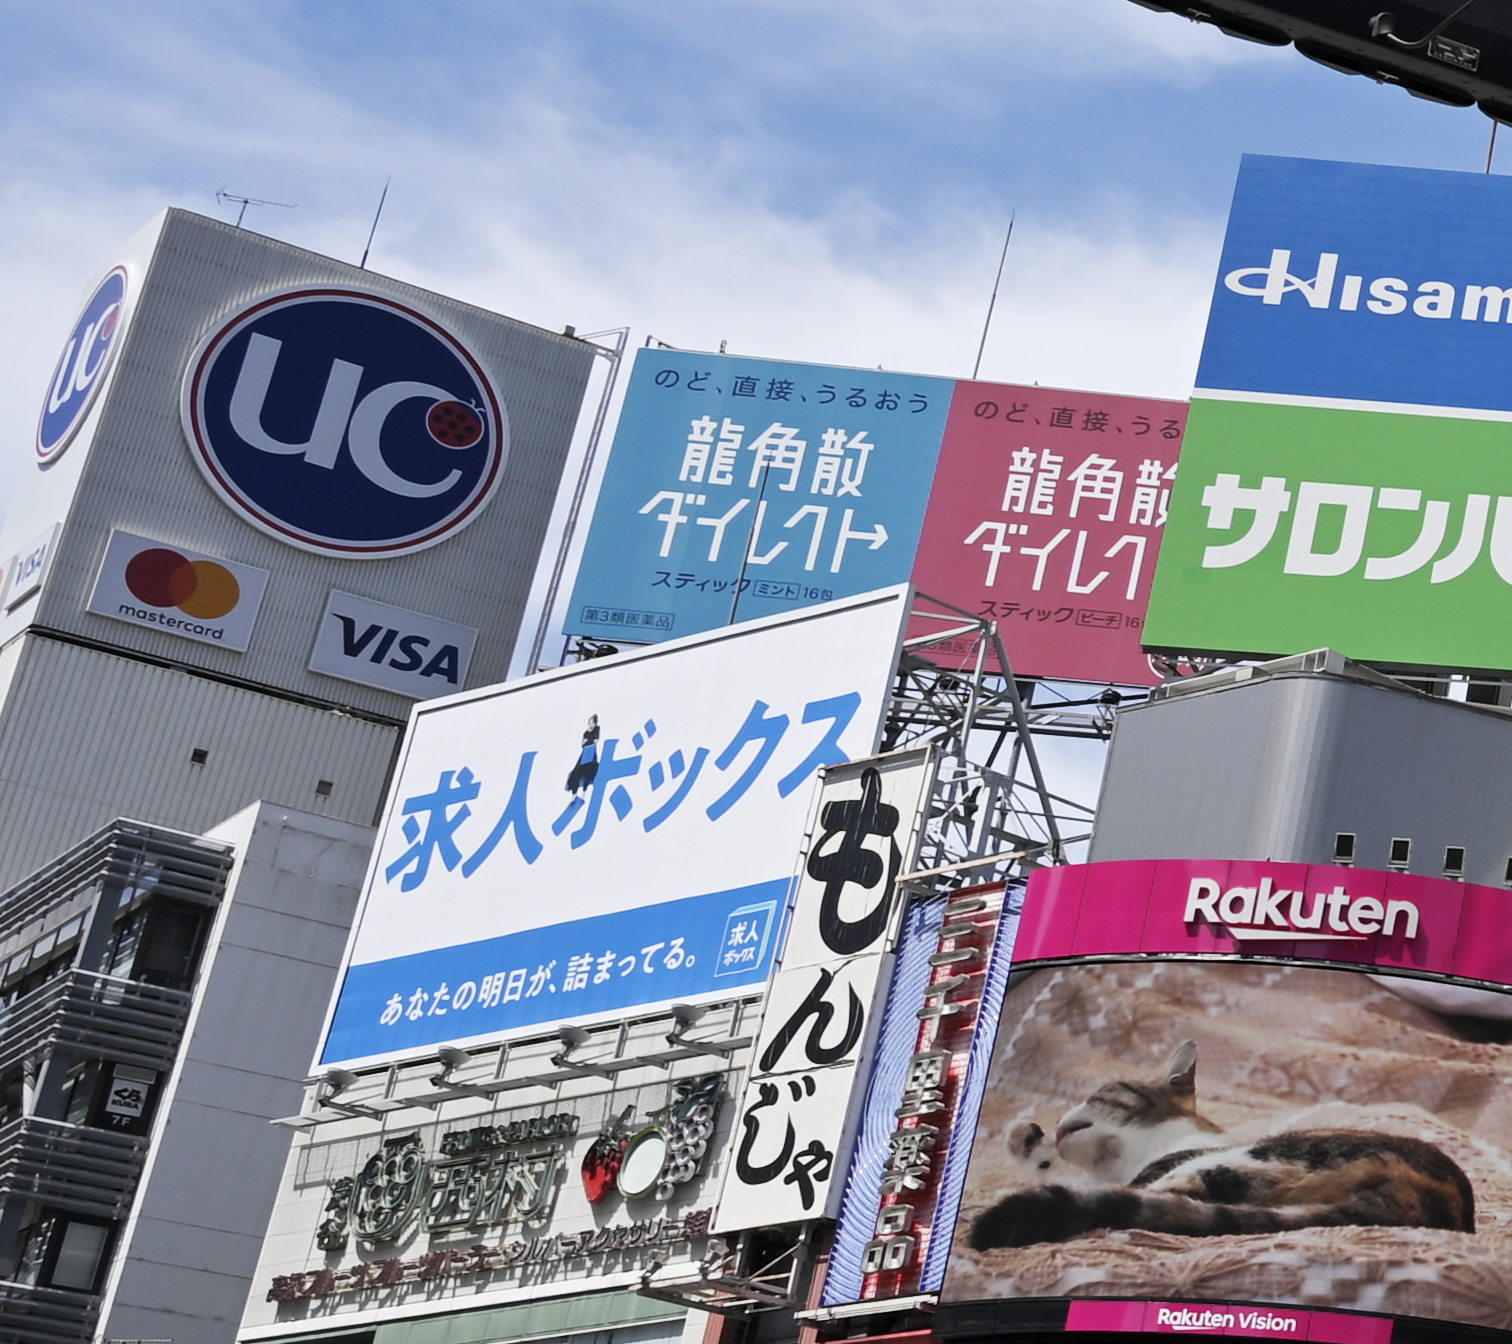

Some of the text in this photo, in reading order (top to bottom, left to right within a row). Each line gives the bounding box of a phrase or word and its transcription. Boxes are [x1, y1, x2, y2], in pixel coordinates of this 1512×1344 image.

[654, 368, 929, 414] のど、直接、うるおう
[678, 414, 875, 499] 龍角散
[1001, 446, 1178, 527] 龍角散
[638, 490, 889, 574] ダイレクト
[651, 570, 750, 595] スティック
[756, 582, 798, 598] ミント
[118, 604, 224, 642] mastercard
[584, 608, 672, 628] 第3類医薬品
[977, 599, 1074, 624] スティック
[332, 613, 463, 686] VISA
[387, 691, 863, 894] 求人ボックス
[1182, 875, 1420, 941] Rakuten
[727, 920, 759, 945] 求人
[723, 948, 757, 966] ボックス
[379, 938, 696, 1026] あなたの明日が、詰まってる。
[736, 766, 901, 1211] もんじゃ
[111, 1098, 139, 1110] KURA
[114, 1087, 141, 1102] くら
[112, 1115, 131, 1126] 7F
[1156, 1307, 1298, 1333] Rakuten Vision
